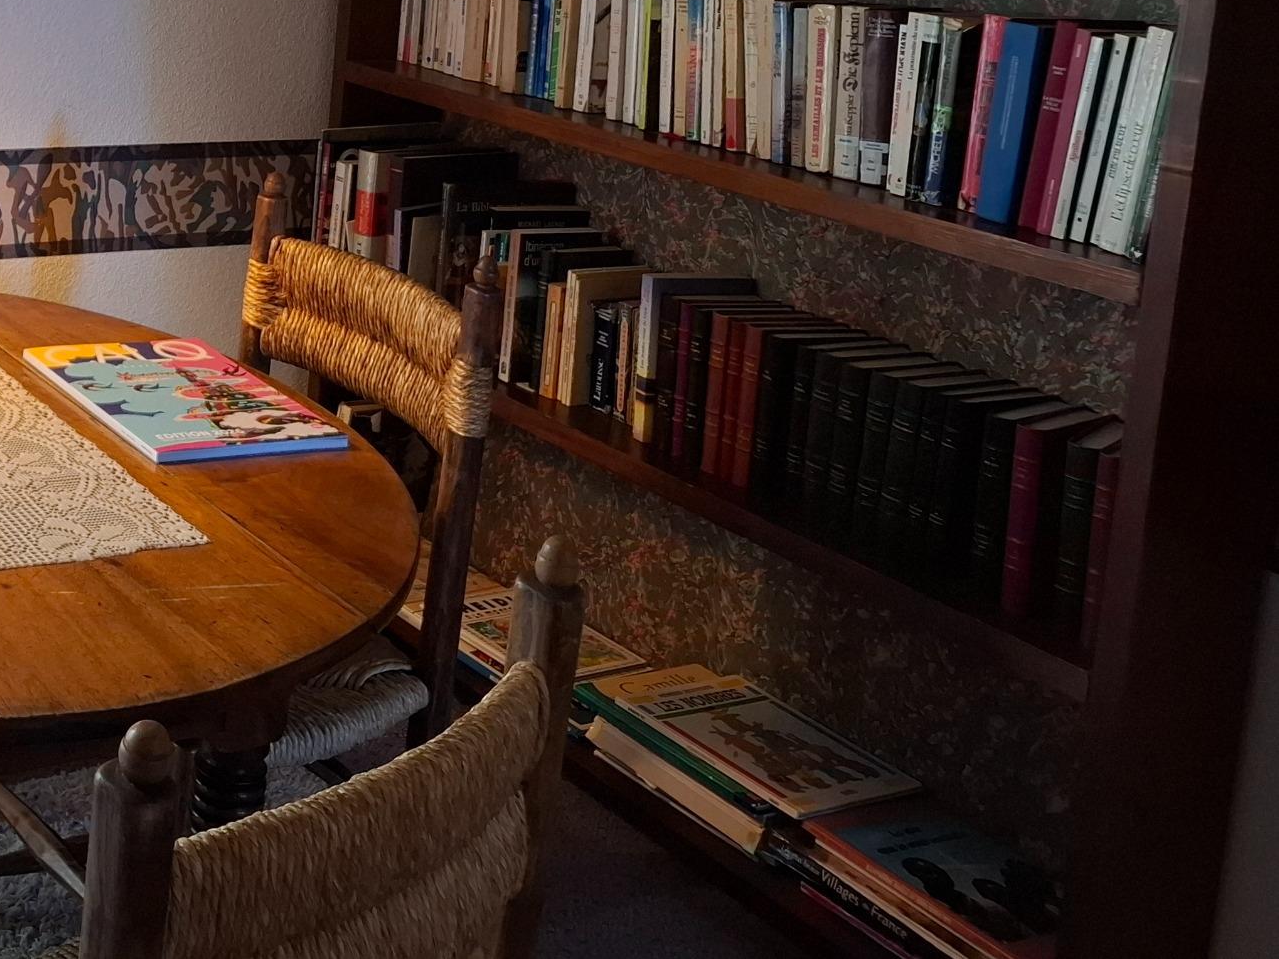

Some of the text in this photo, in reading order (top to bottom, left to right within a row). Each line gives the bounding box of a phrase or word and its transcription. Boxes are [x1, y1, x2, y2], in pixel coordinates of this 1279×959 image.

[899, 31, 907, 55] NEVER
[815, 68, 823, 82] LES
[842, 66, 858, 91] Die
[814, 84, 822, 95] ET
[811, 97, 822, 142] SEMAILLES
[929, 139, 943, 175] MICHEL
[155, 430, 210, 440] EDITION
[619, 674, 695, 694] Camille
[654, 699, 683, 712] LES
[820, 869, 908, 939] Villages France
